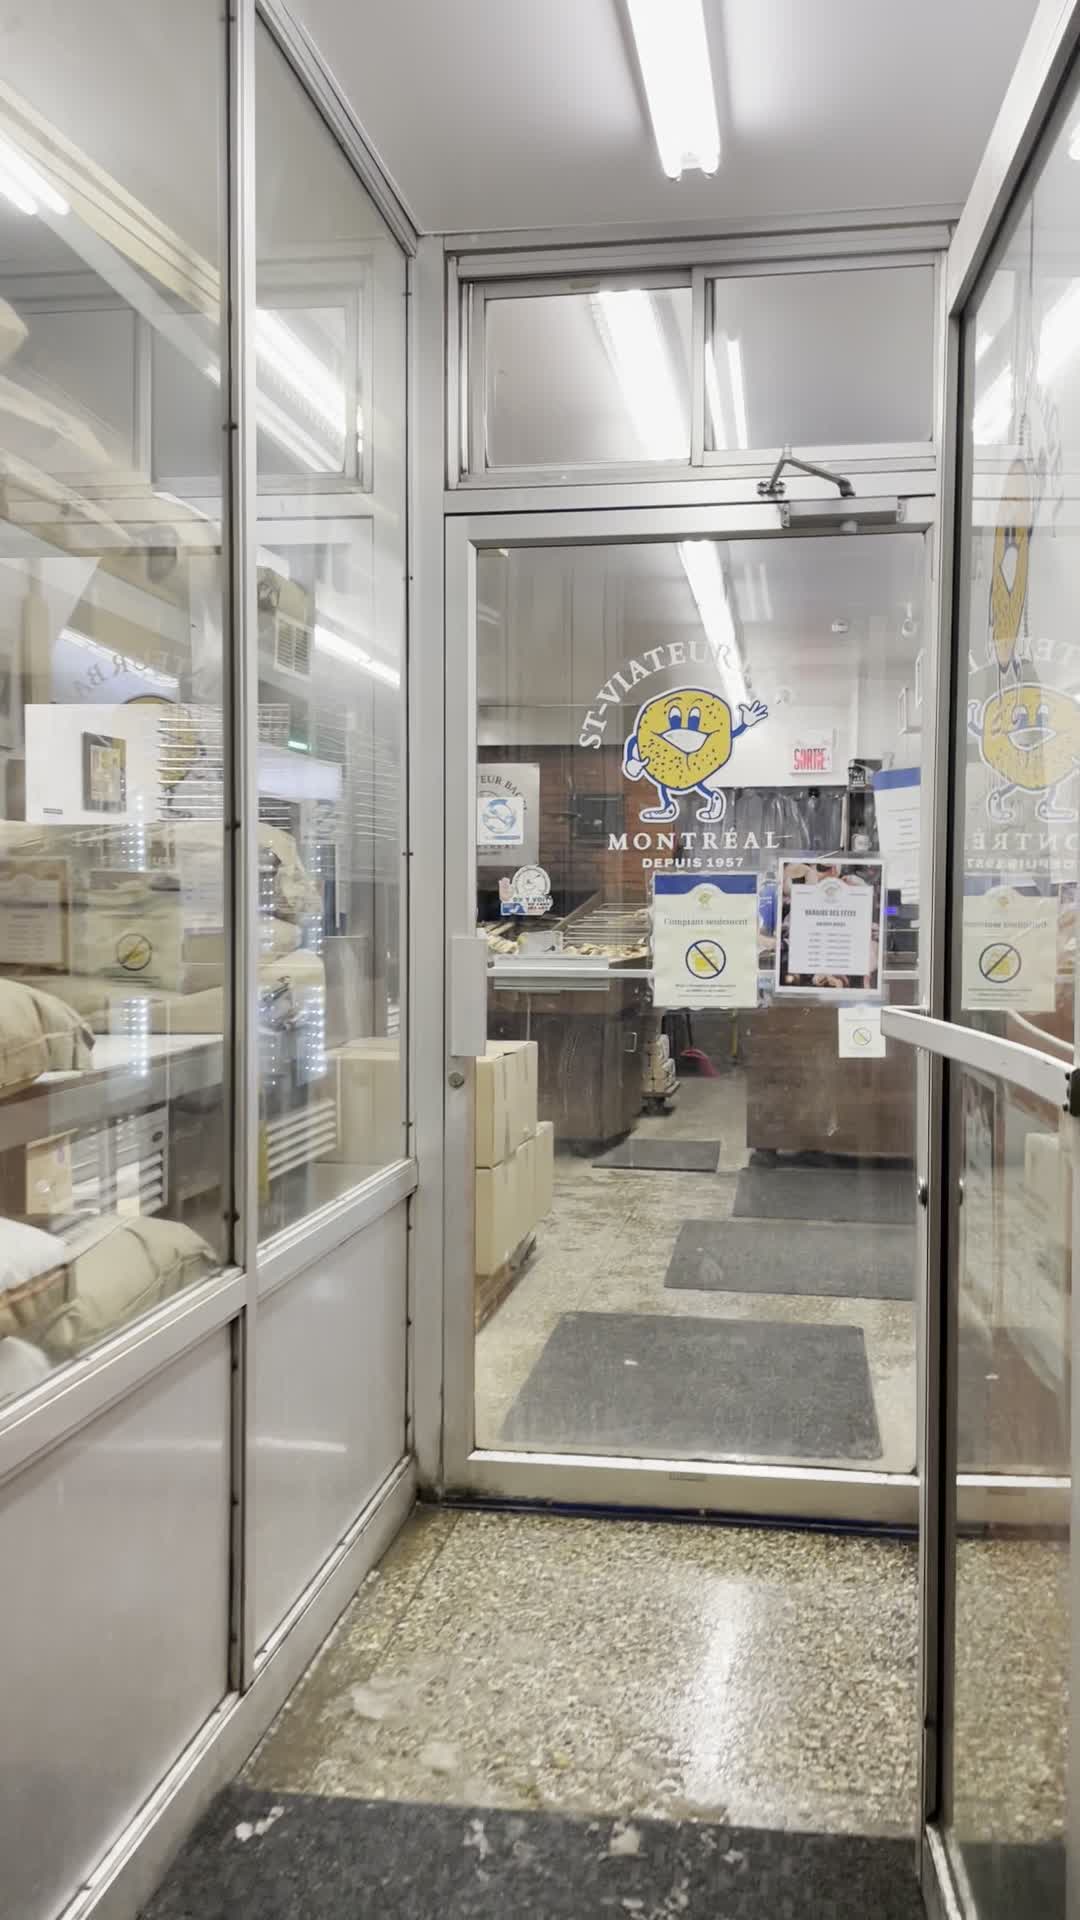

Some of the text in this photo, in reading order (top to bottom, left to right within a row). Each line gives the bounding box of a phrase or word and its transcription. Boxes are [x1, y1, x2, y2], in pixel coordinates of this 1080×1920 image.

[607, 827, 781, 851] MONTRÉAL
[642, 857, 744, 869] DEPUIS 1957
